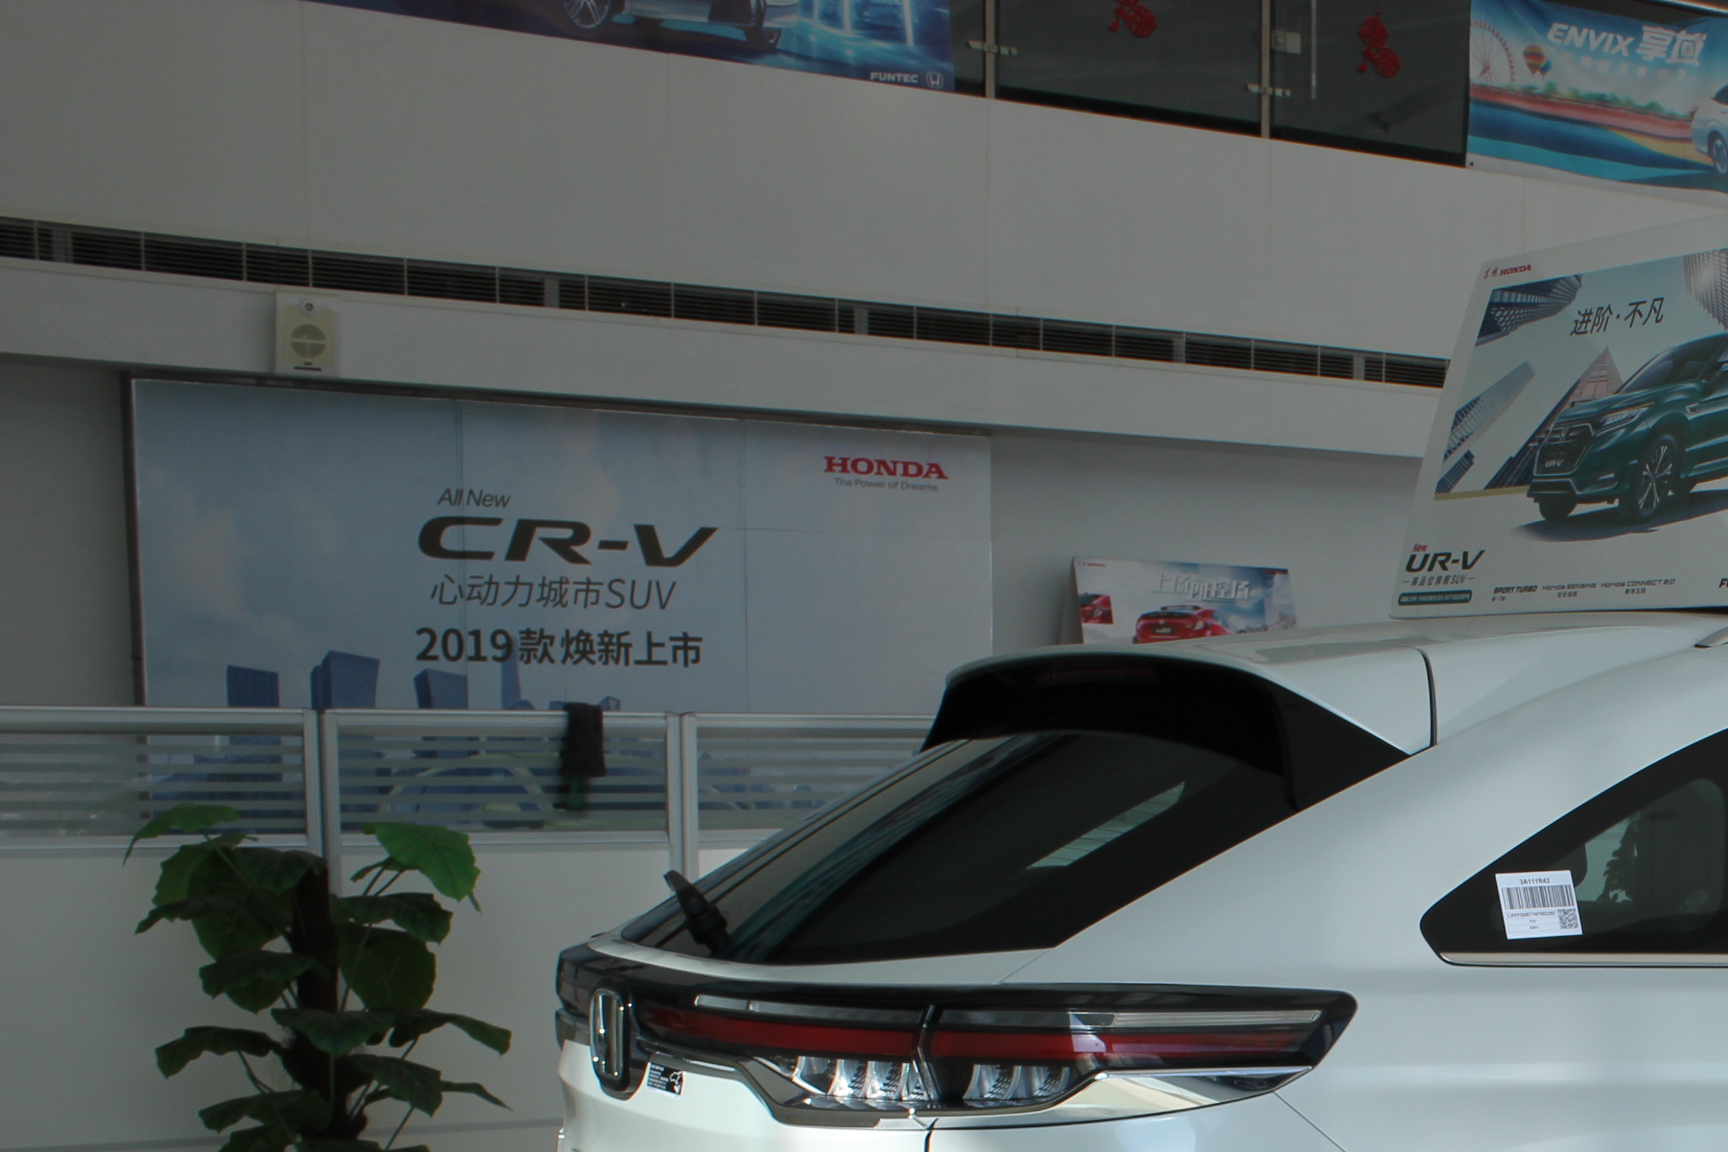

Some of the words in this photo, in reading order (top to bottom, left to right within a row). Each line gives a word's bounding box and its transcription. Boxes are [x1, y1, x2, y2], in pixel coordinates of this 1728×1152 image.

[1547, 22, 1635, 57] ENVIX
[1636, 25, 1707, 66] 享域
[869, 71, 919, 84] FUNTEC
[1500, 264, 1531, 276] HONDA
[824, 455, 949, 480] HONDA
[835, 477, 853, 487] The
[855, 479, 886, 489] Power
[888, 481, 898, 490] of
[901, 481, 938, 492] Dreams
[437, 487, 464, 506] All
[466, 488, 511, 508] New
[417, 515, 719, 567] CR-V
[1406, 549, 1486, 573] UR-V
[430, 574, 677, 610] 心动力城市SUV
[1626, 579, 1662, 587] CONNECT
[415, 627, 703, 668] 2019款焕新上市
